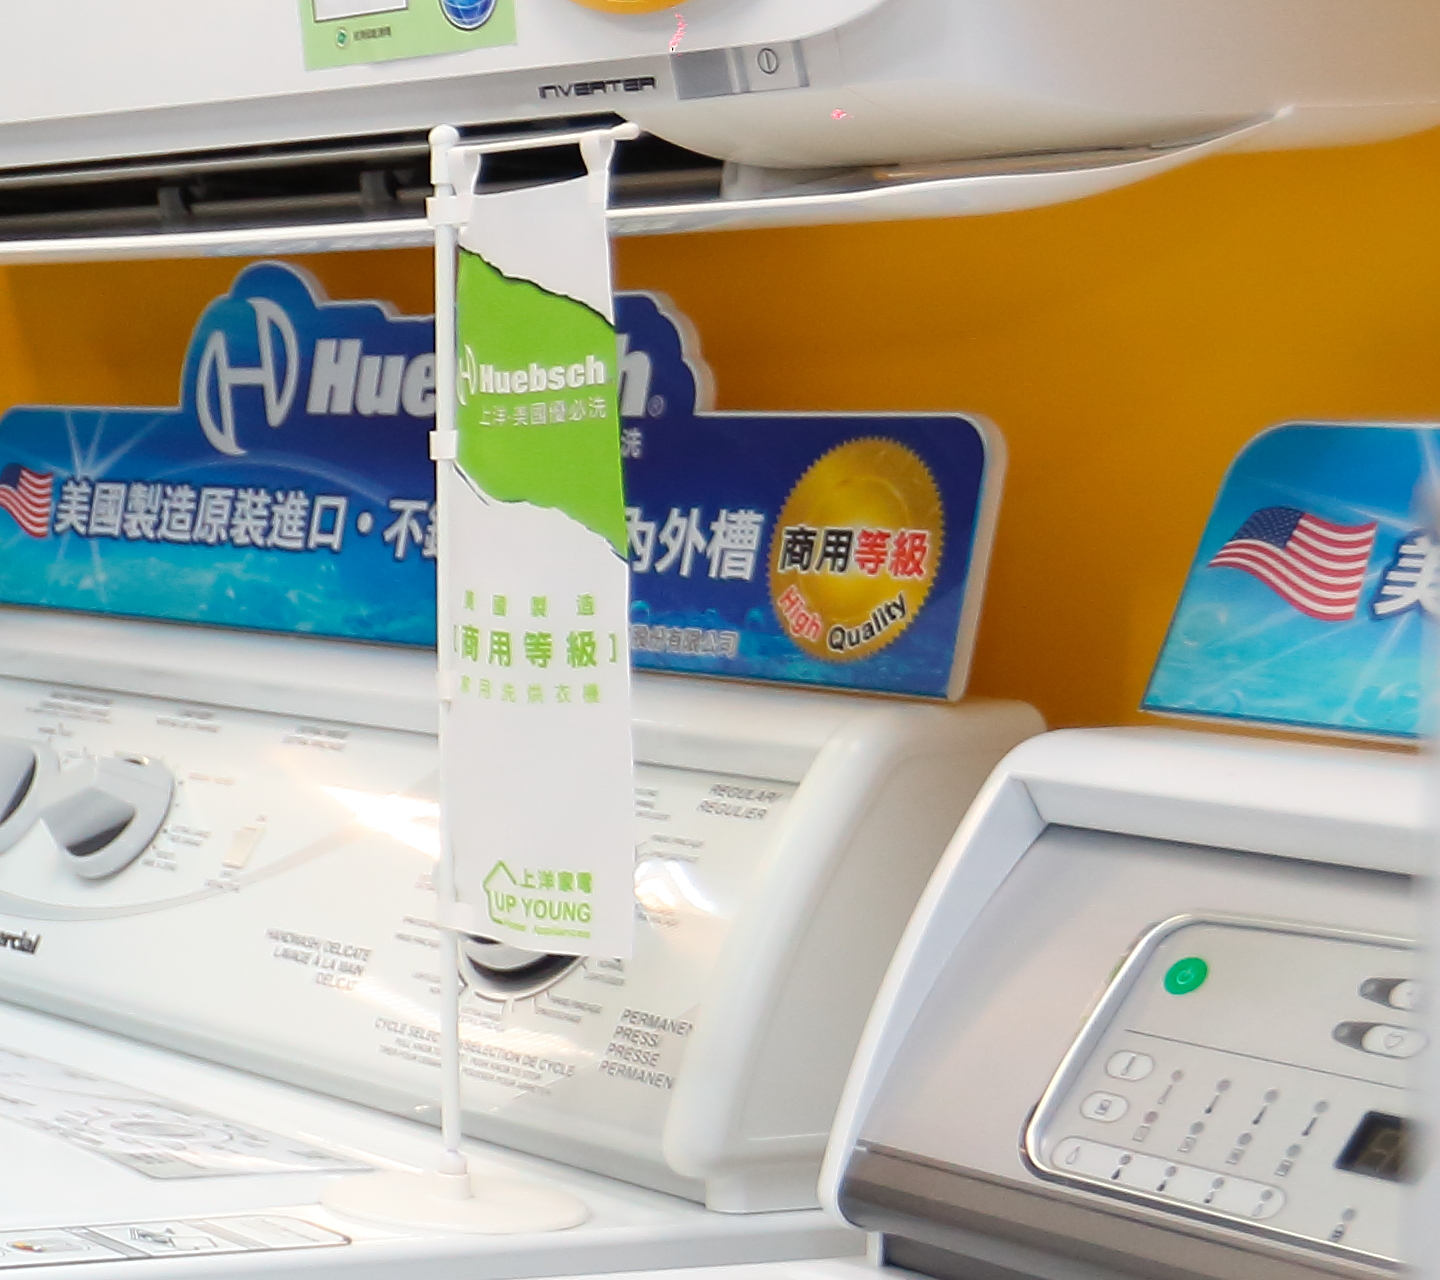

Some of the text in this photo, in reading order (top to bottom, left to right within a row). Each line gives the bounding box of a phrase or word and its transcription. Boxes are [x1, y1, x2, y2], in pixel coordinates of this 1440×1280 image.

[539, 75, 657, 100] INVERTER
[307, 332, 652, 418] Hueh
[479, 354, 606, 395] Huebsch
[778, 524, 930, 580] 商用等級
[777, 585, 908, 652] High Quality
[520, 867, 594, 893] 上洋家電
[493, 891, 592, 924] UP YOUNG
